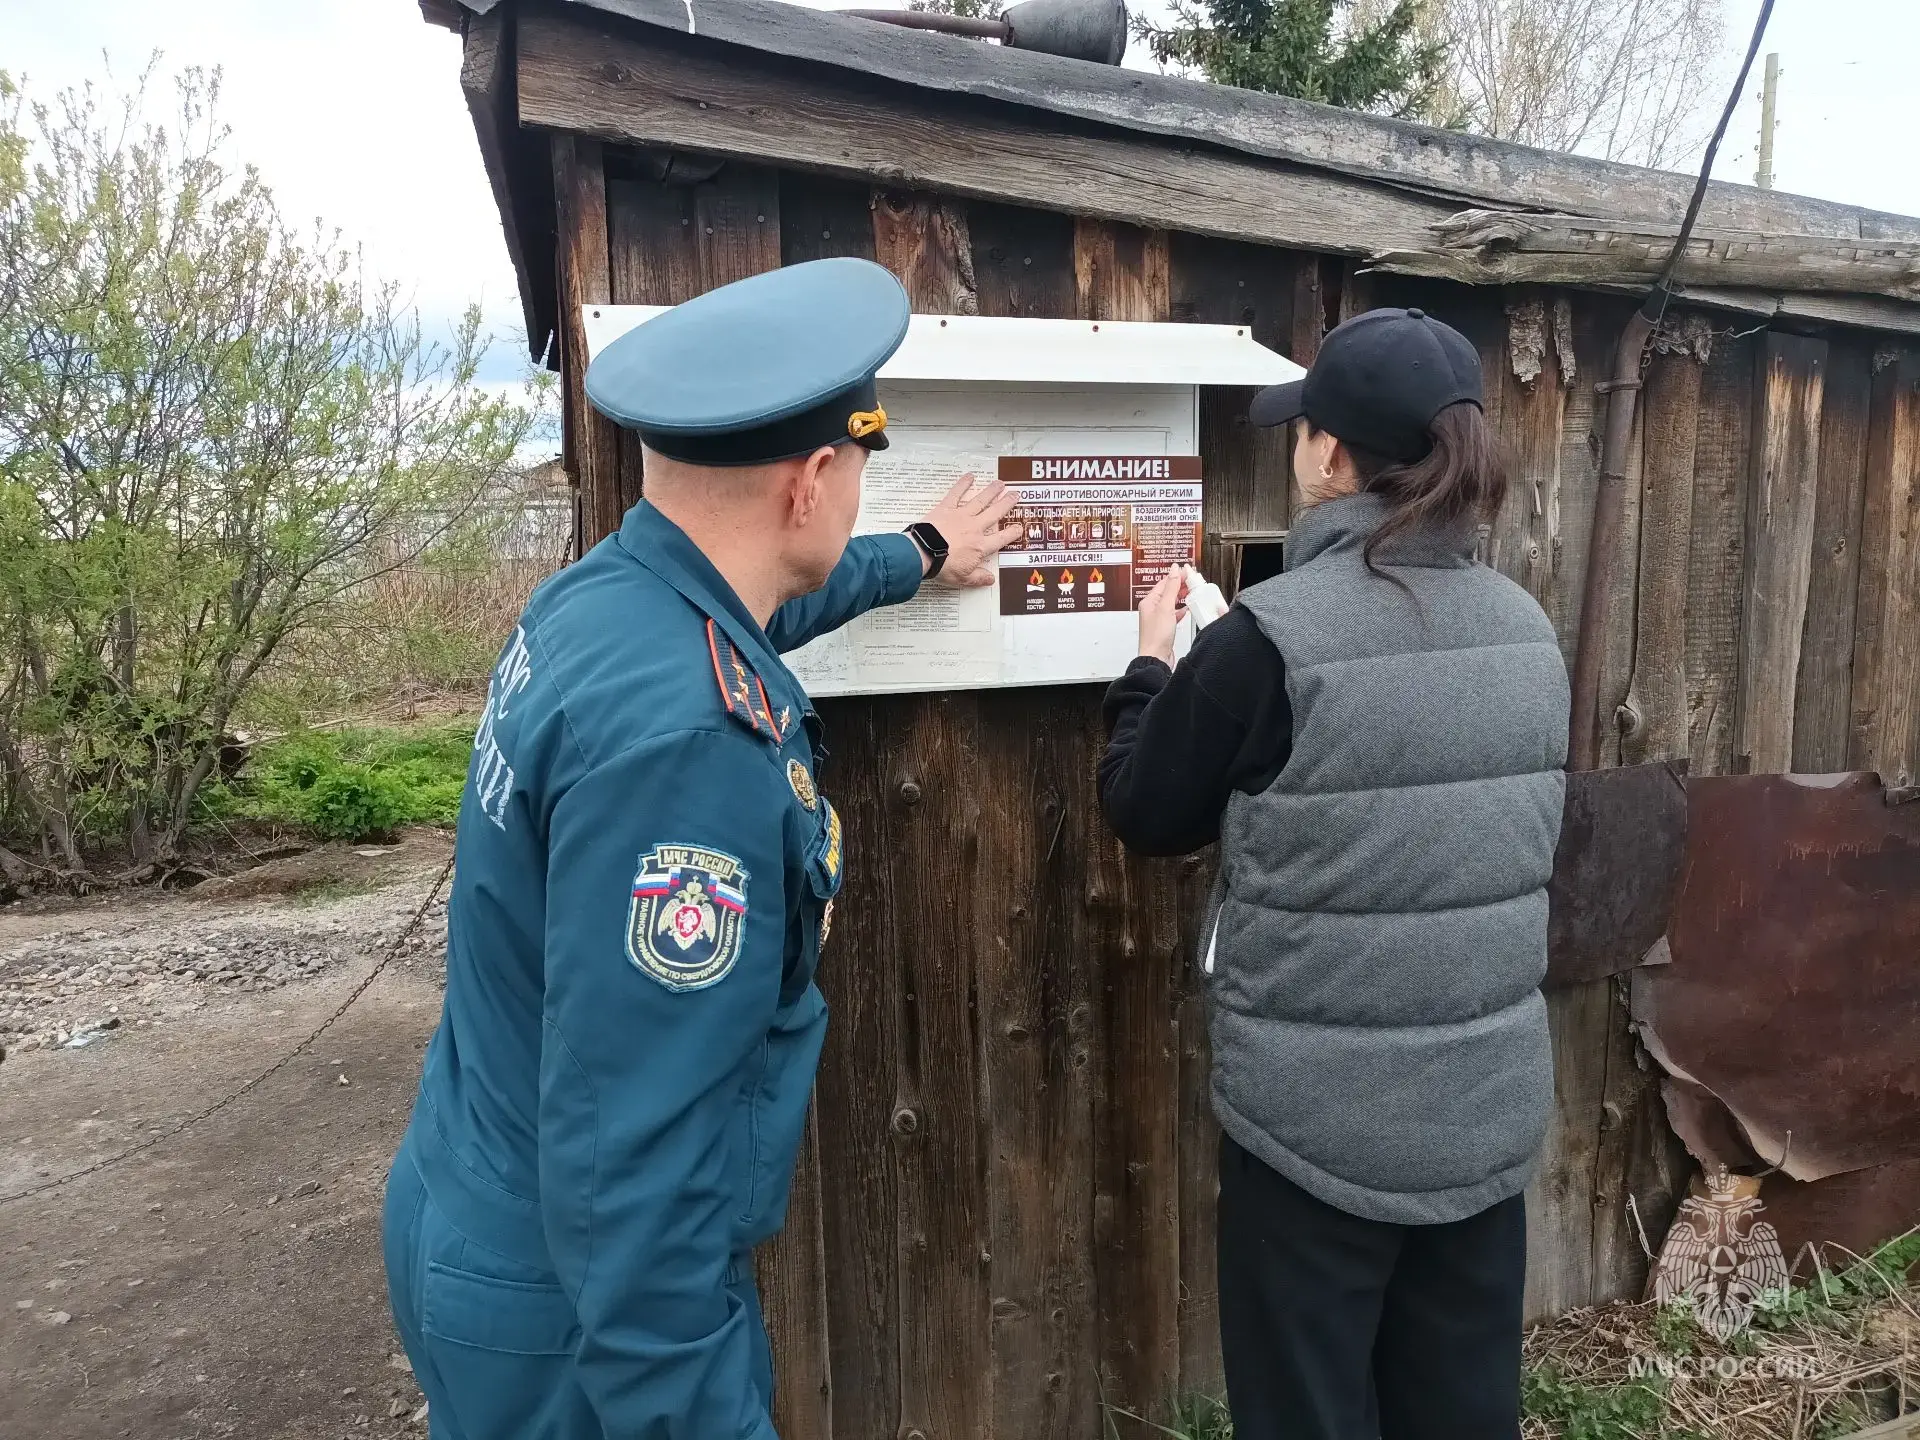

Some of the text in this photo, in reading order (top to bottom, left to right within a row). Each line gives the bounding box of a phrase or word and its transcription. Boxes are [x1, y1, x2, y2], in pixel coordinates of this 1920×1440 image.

[1031, 459, 1170, 479] ВНИМАНИЕ!
[1053, 488, 1157, 500] ПРОТИВОПОЖАРНЫЙ
[1159, 488, 1193, 498] РЕЖИМ
[1024, 508, 1036, 518] ВЫ
[1037, 507, 1080, 519] ОТДЫХАЕТЕ
[1081, 507, 1091, 517] НА
[1092, 506, 1127, 518] ПРИРОДЕ:
[1028, 553, 1103, 563] ЗАПРЕЩАЕТСЯ!!!
[663, 850, 732, 875] МЧС РОССИИ
[637, 897, 737, 981] ГЛАВНОЕ УПРАВЛЕНИЕ ПО СВЕРДЛОВСКОЙ ОБЛАСТИ
